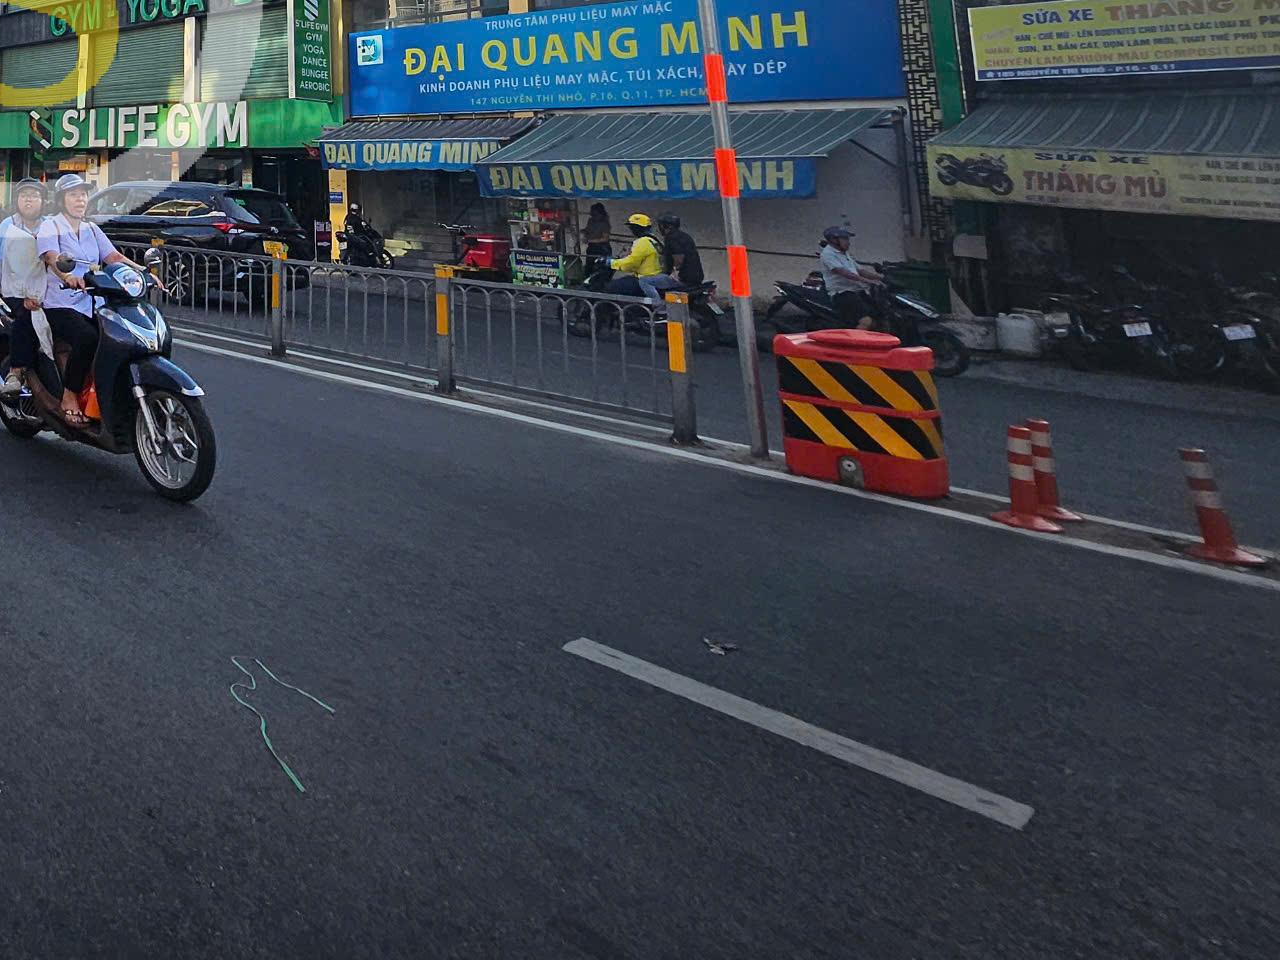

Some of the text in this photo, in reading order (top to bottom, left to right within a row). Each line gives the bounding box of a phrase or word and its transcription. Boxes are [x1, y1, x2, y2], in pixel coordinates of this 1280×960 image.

[486, 0, 673, 31] TRUNG TÂM PHỤ LIỆU MAY MẶC
[1068, 8, 1094, 22] XE
[315, 22, 329, 32] GYM
[305, 33, 323, 42] GYM
[303, 43, 325, 55] YOGA
[403, 10, 809, 82] ĐẠI QUANG MNH
[1153, 45, 1233, 60] COMPOSIT
[302, 55, 328, 68] DANCE
[301, 68, 329, 80] BUNGEE
[420, 81, 447, 94] KINH
[449, 77, 491, 92] DOANH
[494, 76, 520, 91] PHỤ
[522, 72, 551, 88] LIỆU
[555, 72, 585, 85] MAY
[627, 67, 651, 82] TÚI
[656, 63, 703, 81] XÁCH,
[753, 60, 788, 75] DÉP
[299, 80, 331, 92] AEROBIC
[471, 97, 488, 106] 147
[490, 93, 535, 105] NGUYỄN
[536, 93, 554, 105] THỊ
[657, 89, 673, 99] TP.
[60, 100, 248, 149] S'LIFE GYM
[324, 142, 501, 168] ĐẠI QUANG MIN
[1108, 154, 1151, 165] XE
[489, 159, 795, 194] ĐẠI QUANG MNH
[1022, 163, 1117, 194] THẮNG
[526, 254, 544, 262] QUANG
